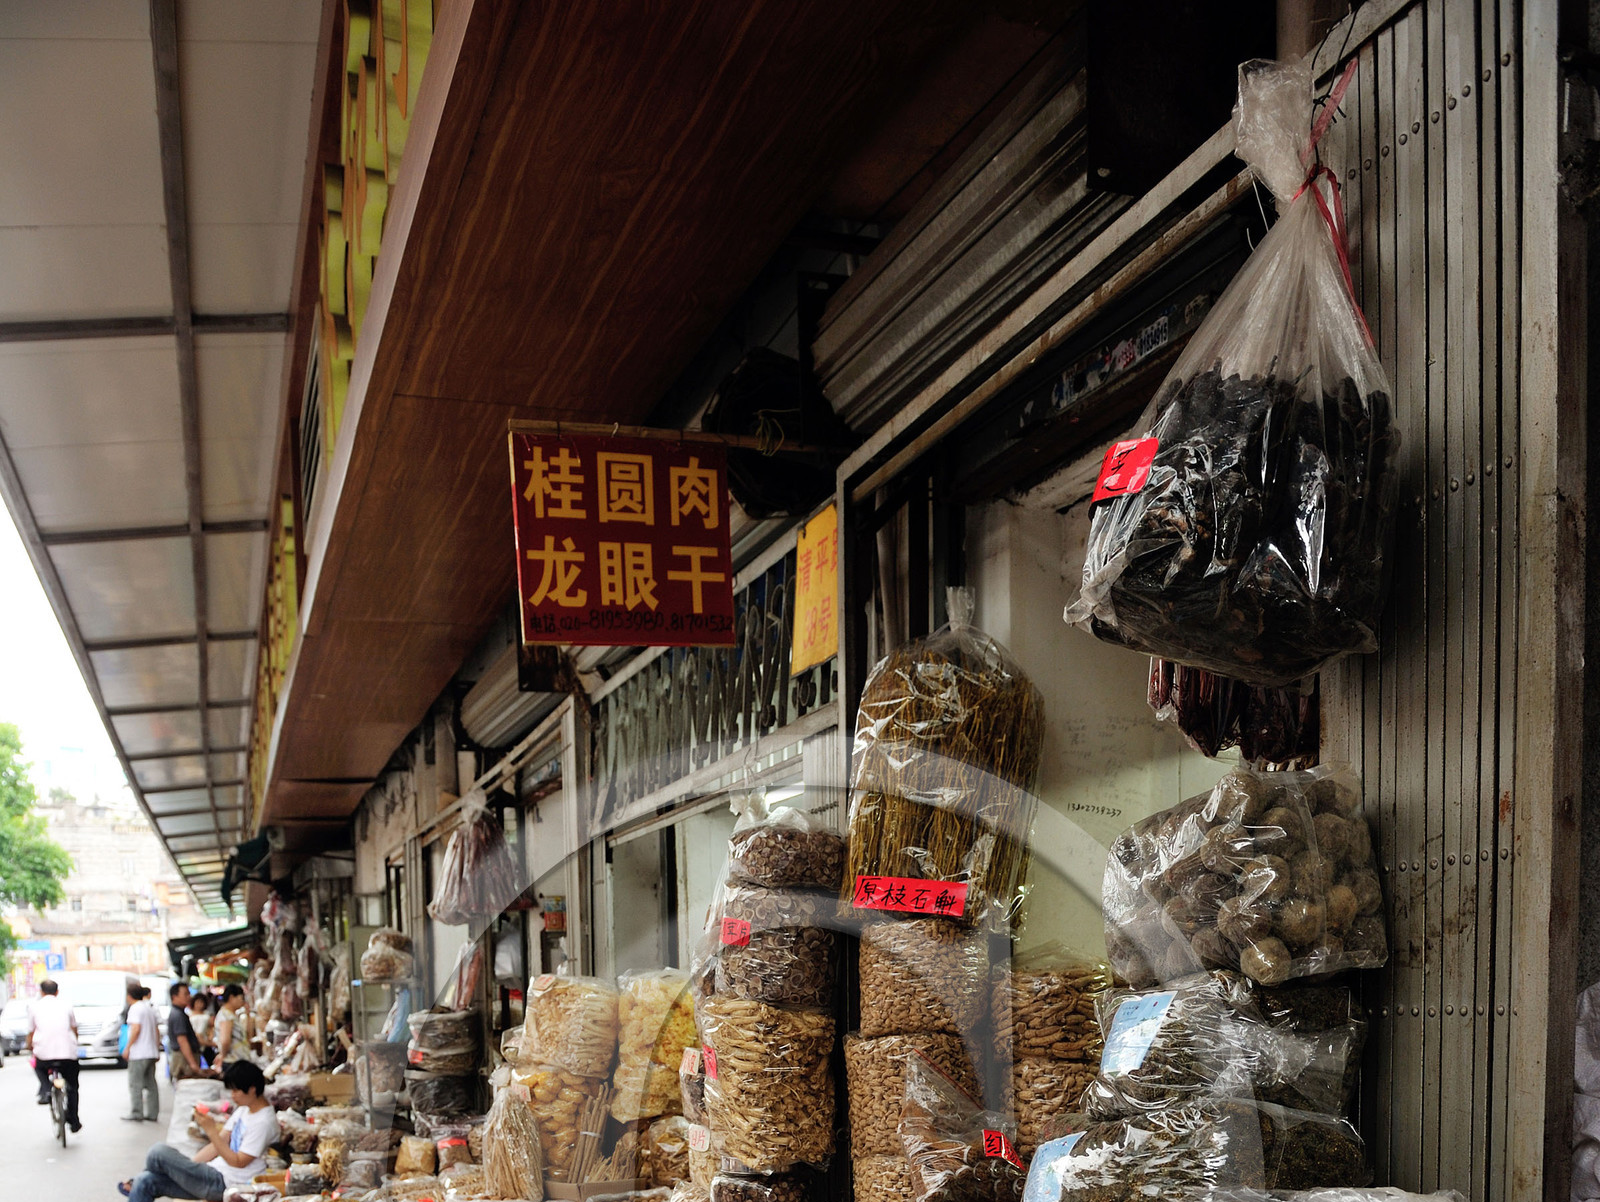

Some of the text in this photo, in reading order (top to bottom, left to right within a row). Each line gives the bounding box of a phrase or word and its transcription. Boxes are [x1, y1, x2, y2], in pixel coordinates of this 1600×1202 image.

[523, 446, 720, 529] 桂圆肉
[526, 535, 726, 614] 龙眼干
[853, 877, 957, 914] 原枝石斛
